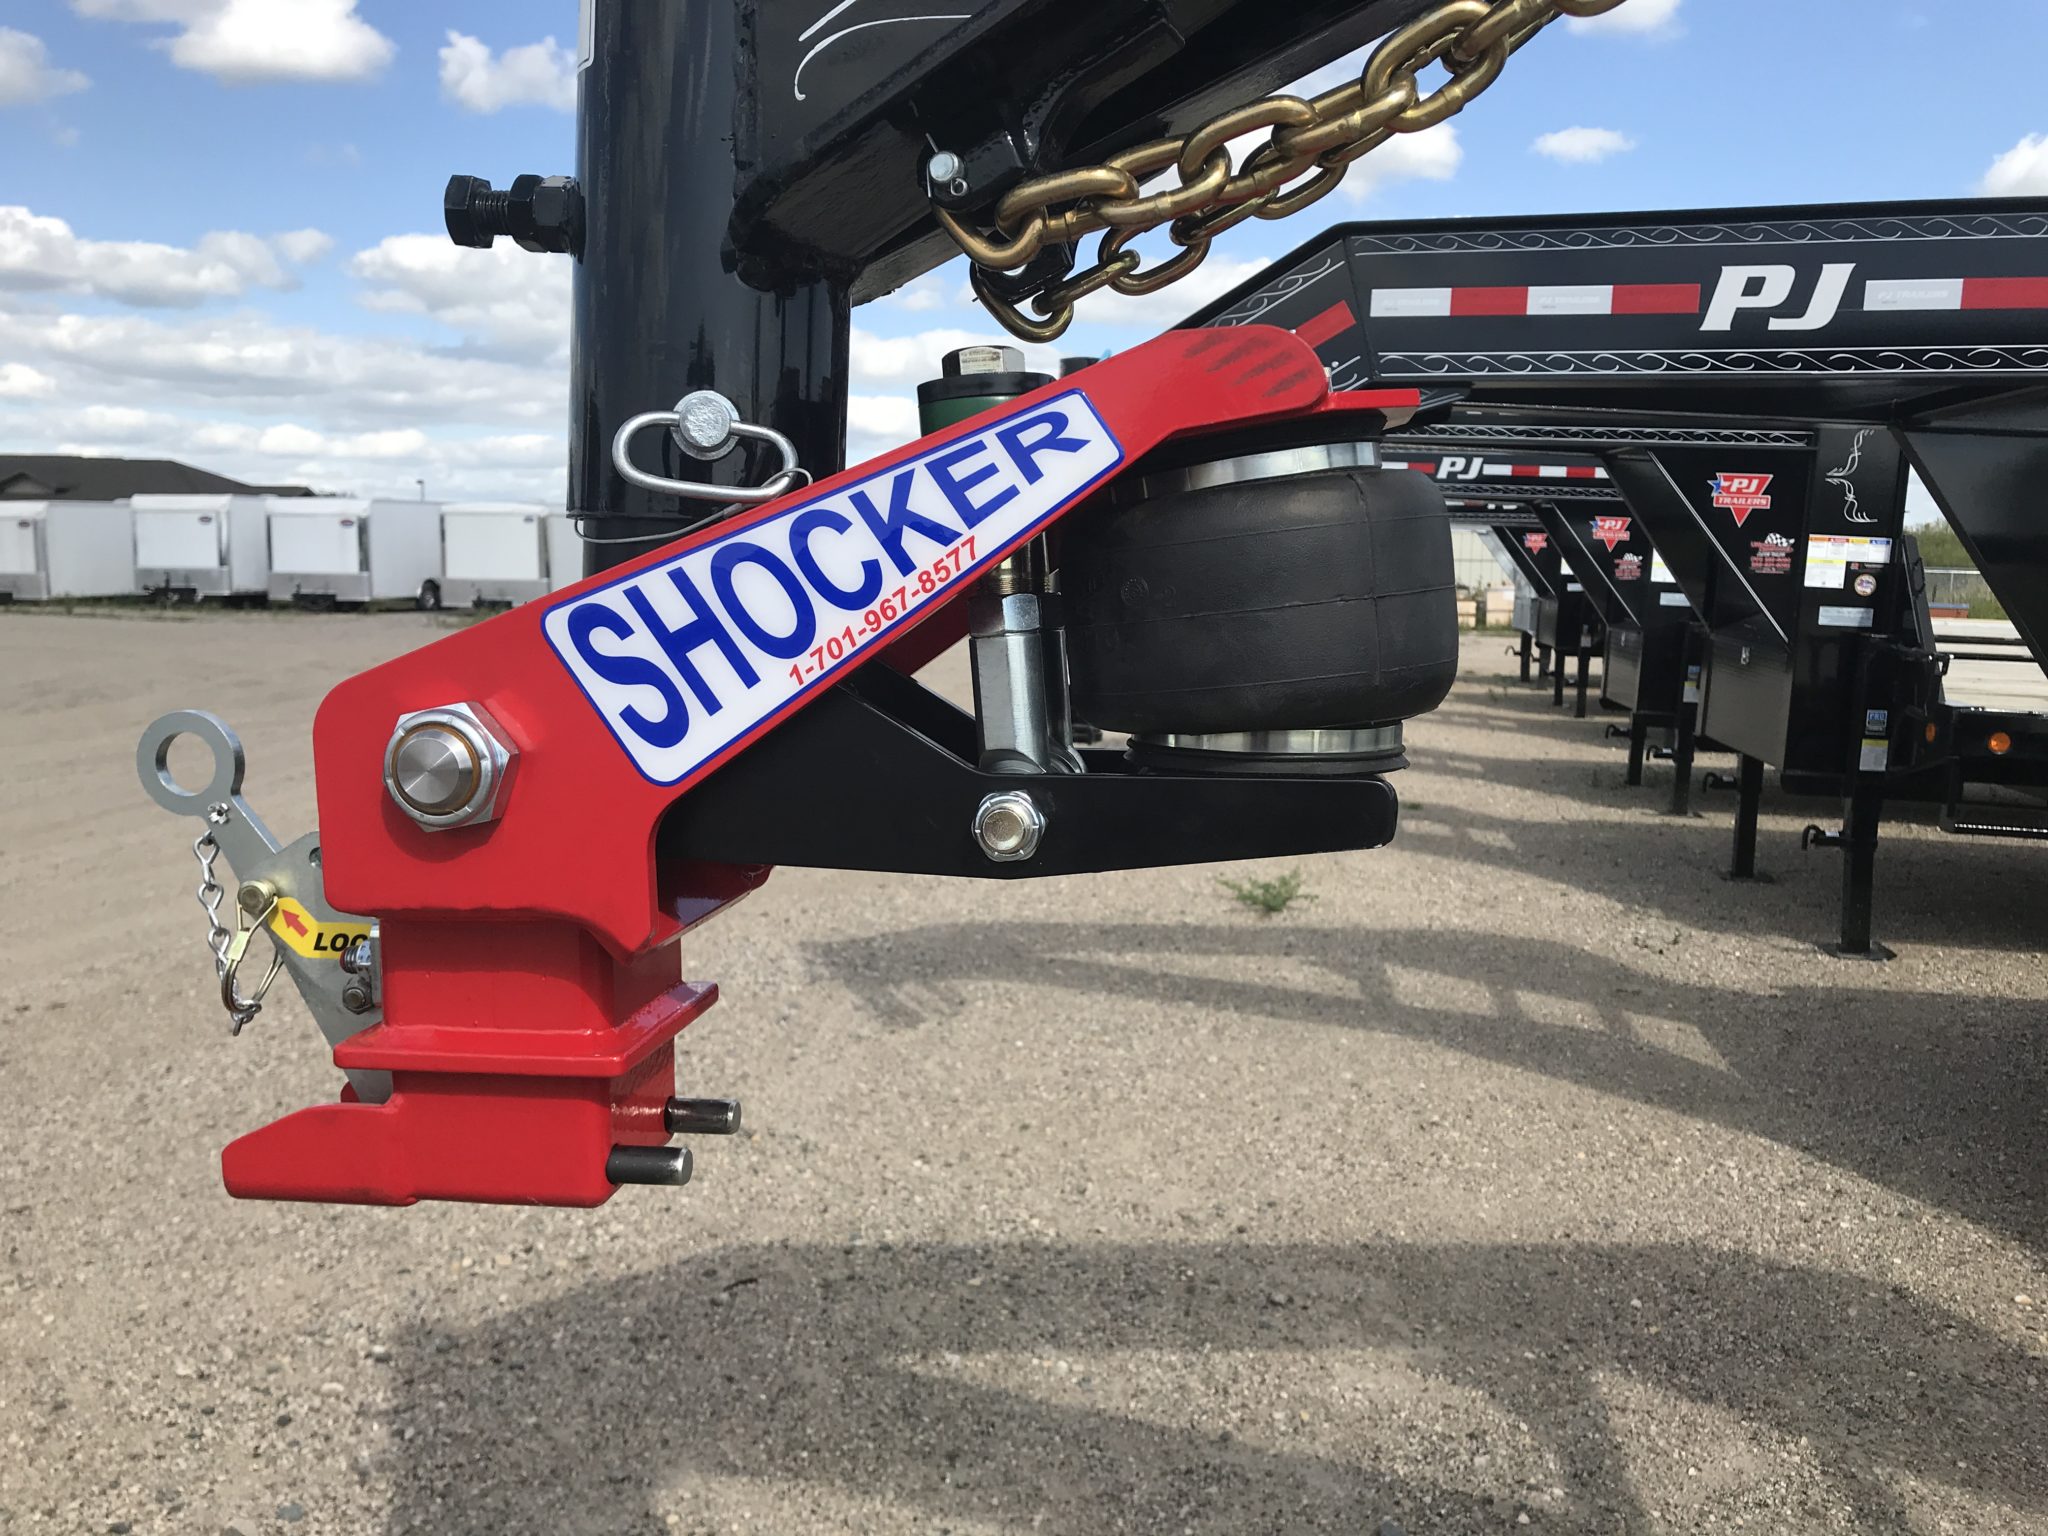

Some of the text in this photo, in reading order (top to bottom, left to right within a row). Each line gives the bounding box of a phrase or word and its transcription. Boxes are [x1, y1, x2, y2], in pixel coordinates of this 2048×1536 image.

[1699, 262, 1857, 331] PJ
[1436, 456, 1484, 480] PJ
[1729, 478, 1759, 493] PJ
[1718, 496, 1767, 506] TRAILERS
[566, 410, 1091, 749] SHOCKER
[788, 534, 977, 687] 1-701-967-8577
